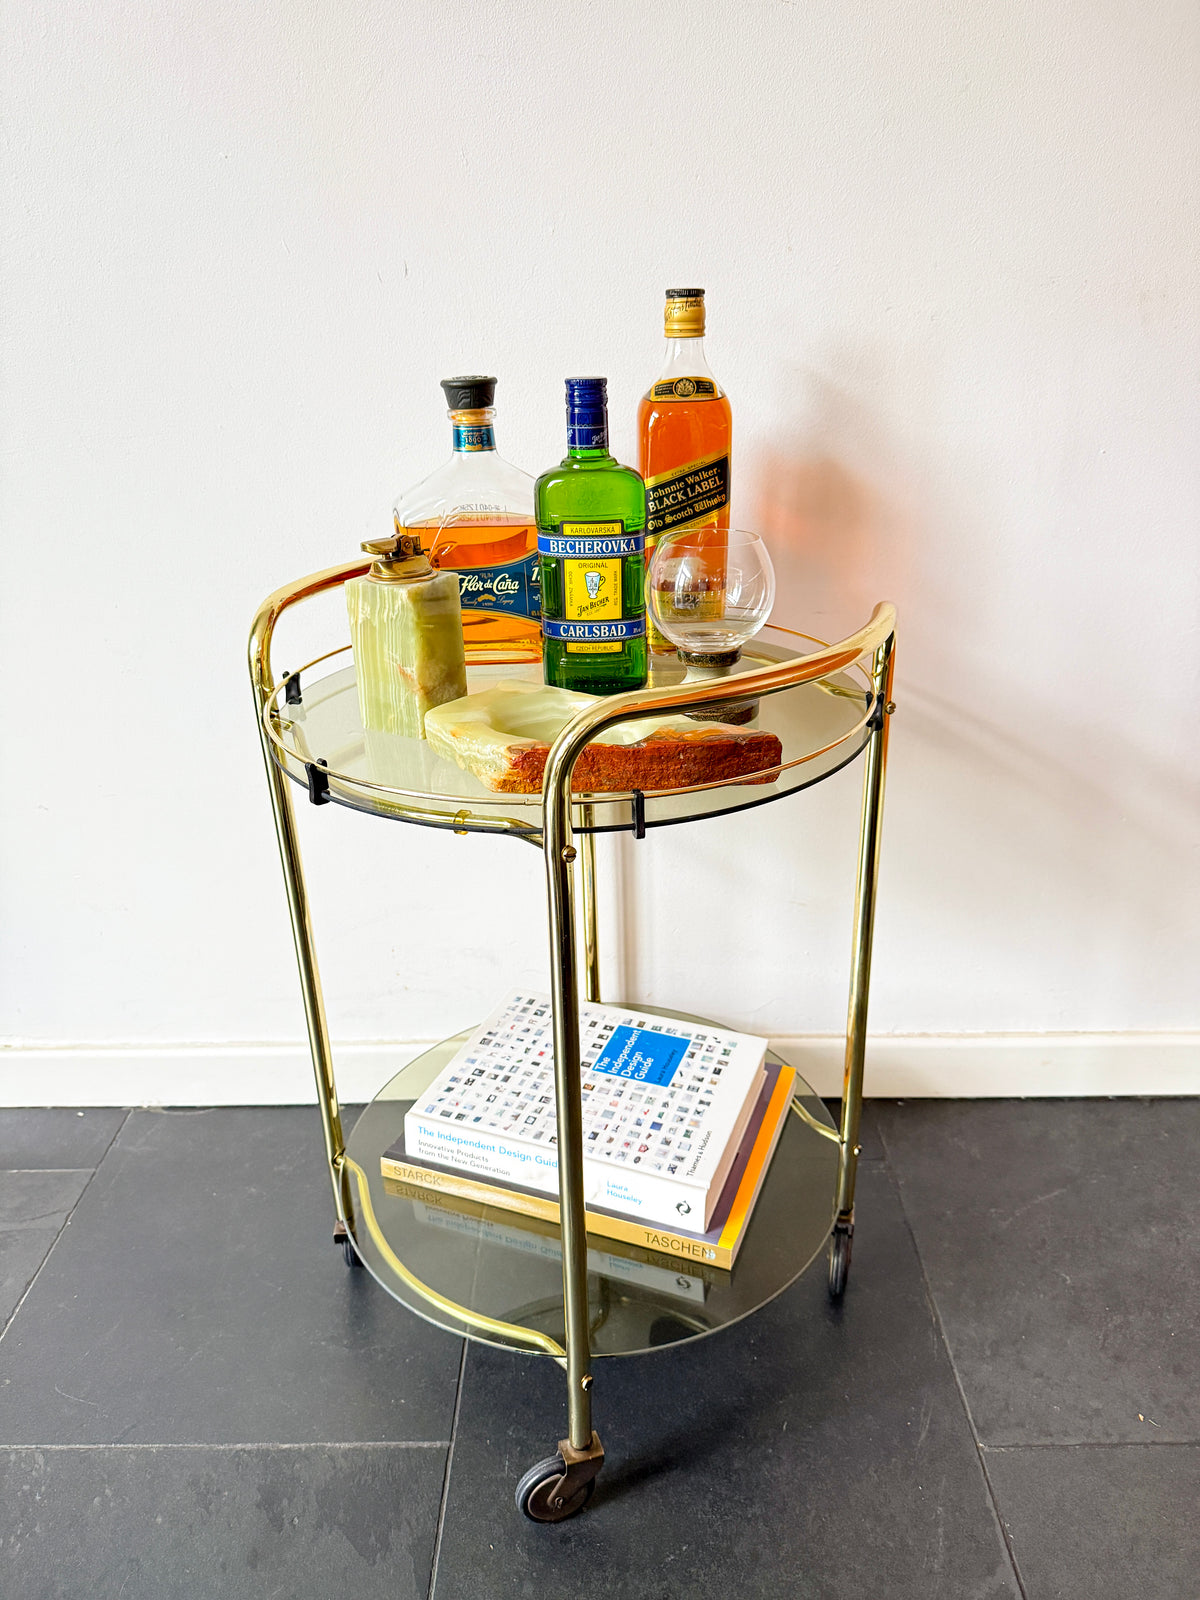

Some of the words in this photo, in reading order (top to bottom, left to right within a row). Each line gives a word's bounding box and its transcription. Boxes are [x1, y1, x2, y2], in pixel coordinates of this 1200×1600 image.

[648, 490, 686, 513] BLACK
[687, 476, 724, 498] LABEL
[649, 481, 685, 501] Johnnie
[647, 519, 663, 531] Old
[664, 506, 694, 524] Scotch
[693, 493, 726, 512] Whisky
[549, 538, 636, 554] BECHEROVKA
[458, 574, 483, 596] Flor
[484, 581, 493, 589] de
[493, 573, 519, 595] Caña
[560, 624, 626, 638] CARLSBAD
[594, 1056, 611, 1070] The
[608, 1030, 641, 1074] Independent
[621, 1051, 643, 1077] Design
[634, 1057, 654, 1080] Guide
[418, 1126, 435, 1137] The
[437, 1131, 495, 1152] Independent
[499, 1146, 532, 1162] Design
[535, 1155, 558, 1168] Guid
[418, 1139, 455, 1154] Innovative
[456, 1149, 489, 1163] Products
[686, 1153, 702, 1177] Thames
[699, 1130, 712, 1151] Hudson
[418, 1147, 436, 1157] from
[437, 1152, 450, 1160] the
[451, 1155, 468, 1165] New
[469, 1160, 511, 1176] Generation
[393, 1166, 441, 1186] STARCK
[607, 1180, 629, 1192] Laura
[607, 1189, 643, 1205] Houseley
[644, 1231, 713, 1259] TASCHEN
